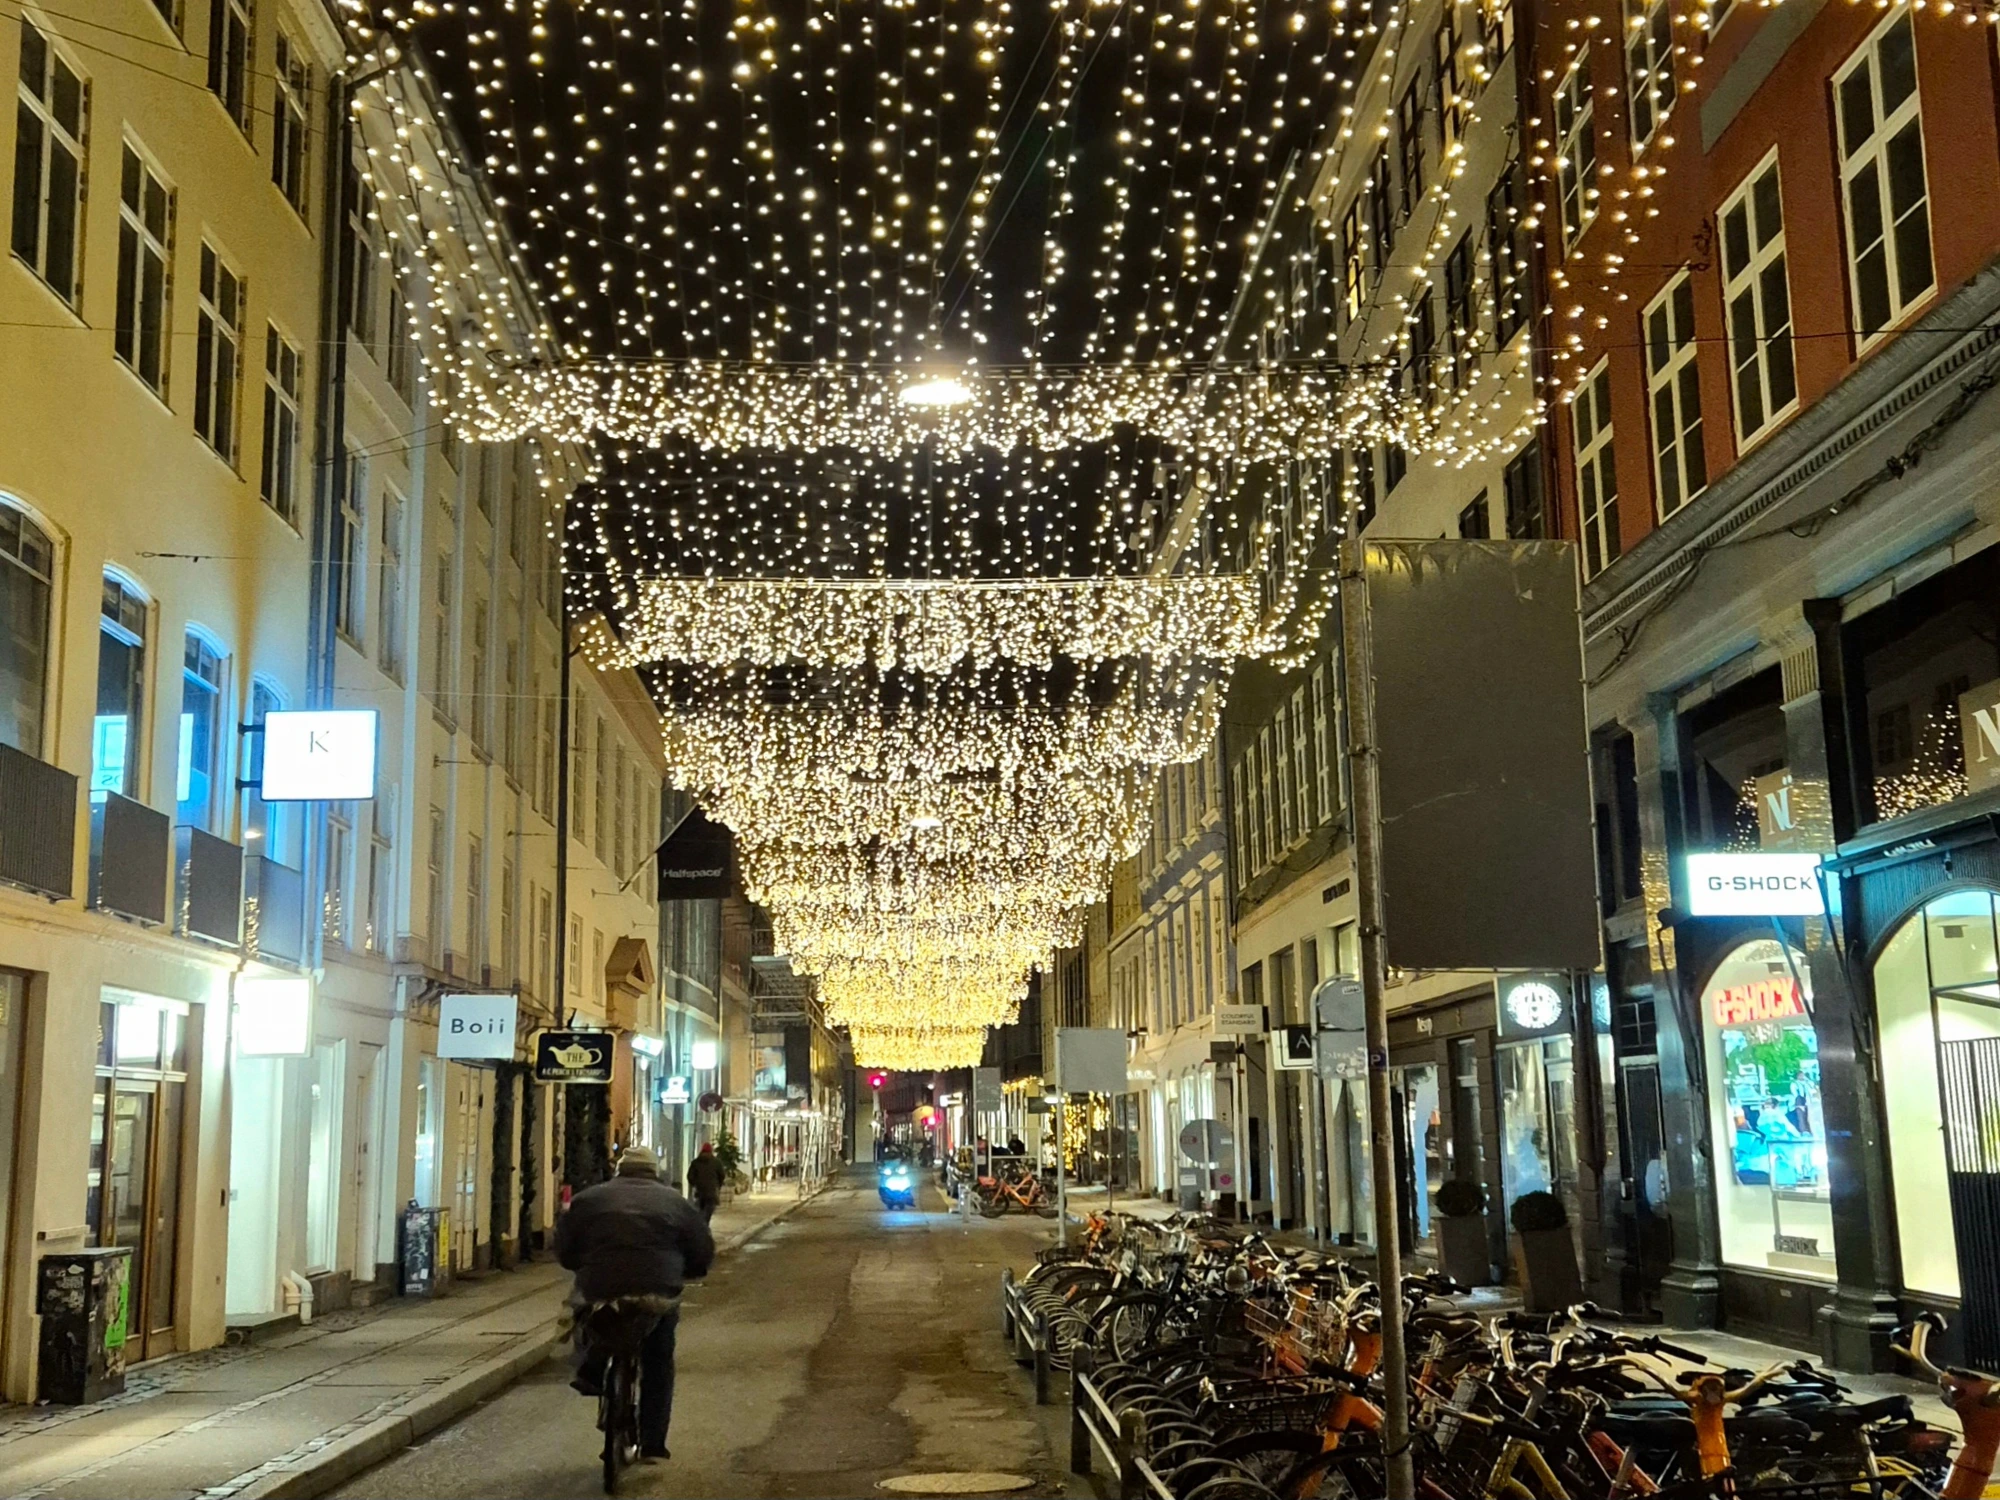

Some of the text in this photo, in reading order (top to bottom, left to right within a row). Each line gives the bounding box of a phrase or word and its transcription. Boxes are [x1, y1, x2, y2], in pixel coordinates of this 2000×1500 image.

[310, 731, 329, 753] K
[663, 868, 721, 879] Halfspace
[1708, 876, 1813, 891] G-SHOCK
[1713, 978, 1802, 1026] G-SHOCK
[451, 1018, 504, 1034] Boii
[566, 1052, 585, 1063] THE
